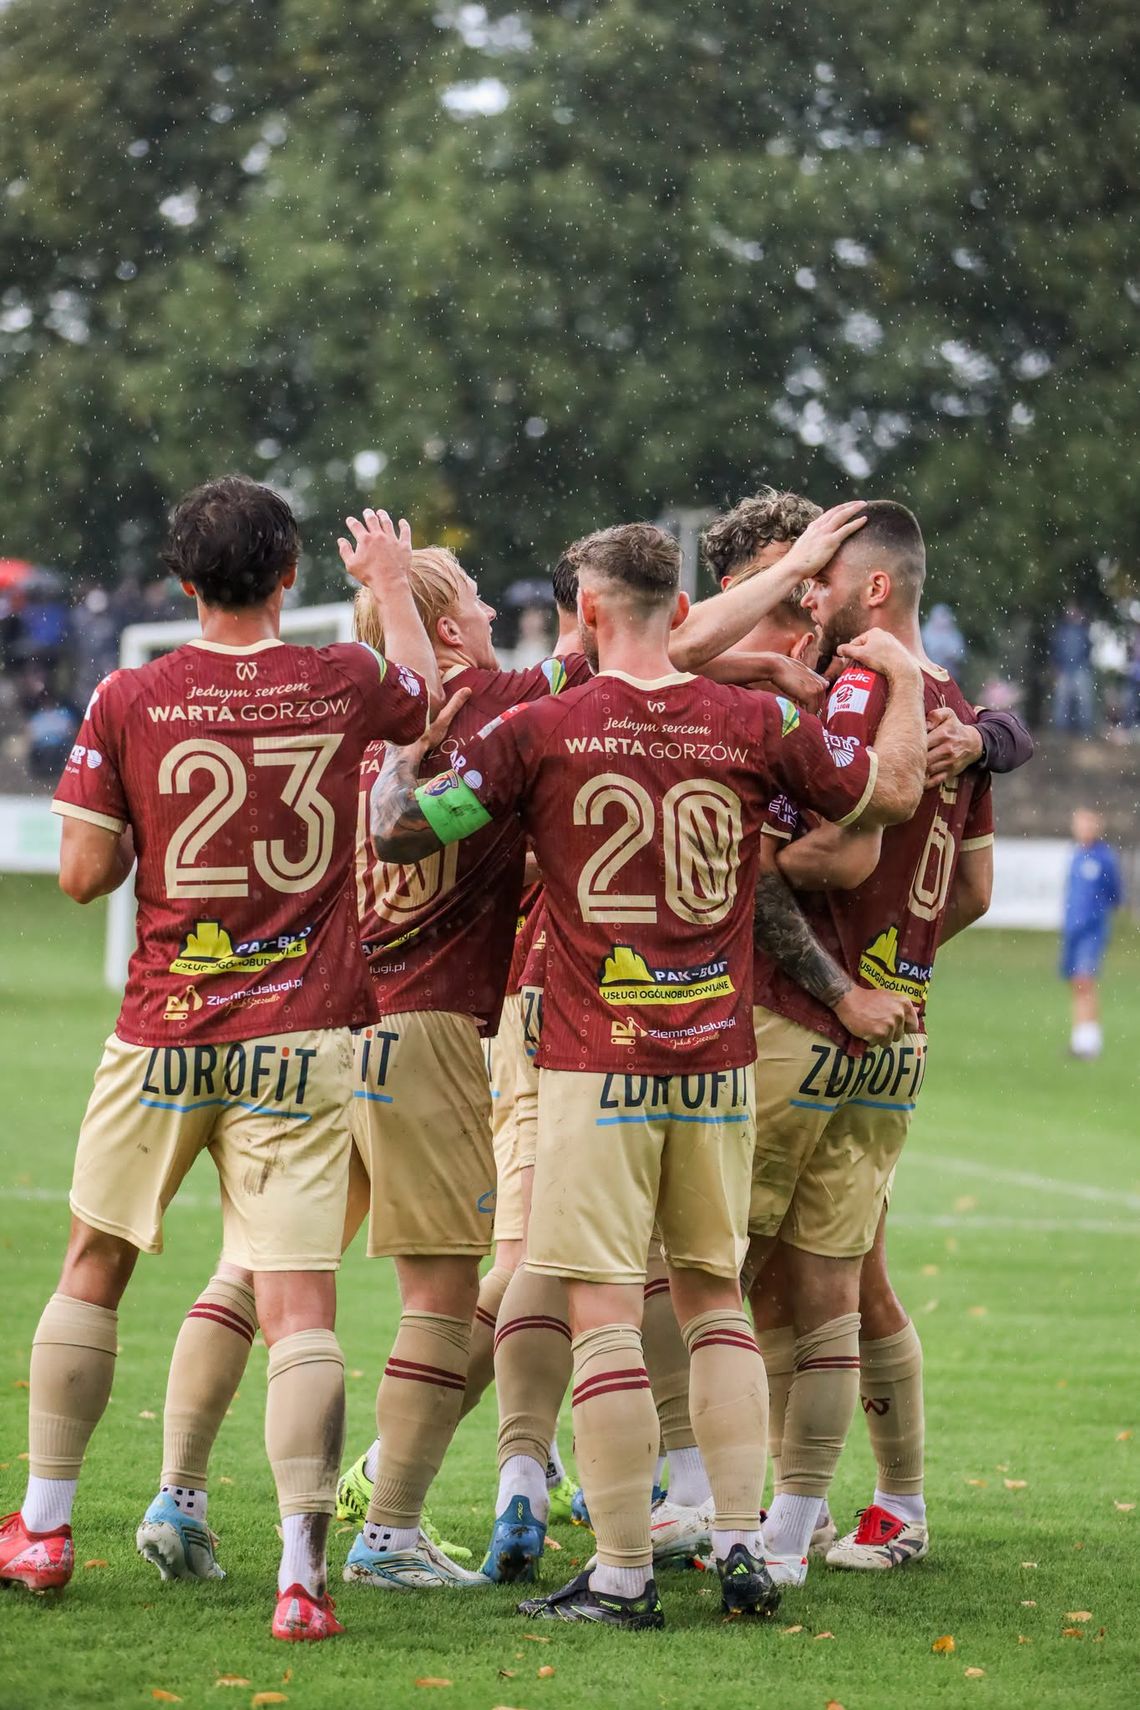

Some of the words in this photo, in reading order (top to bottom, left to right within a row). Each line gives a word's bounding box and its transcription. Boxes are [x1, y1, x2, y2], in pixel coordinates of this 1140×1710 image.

[188, 685, 251, 704] Jednym
[254, 682, 311, 698] sercem
[147, 704, 236, 723] WARTA
[240, 695, 352, 722] GORZÓW
[603, 716, 659, 737] Jednym
[661, 722, 712, 736] sercem
[565, 737, 647, 757] WARTA
[649, 741, 749, 764] GORZÓW
[158, 733, 345, 899] 23
[573, 773, 743, 925] 20
[603, 989, 638, 1000] USŁUGI
